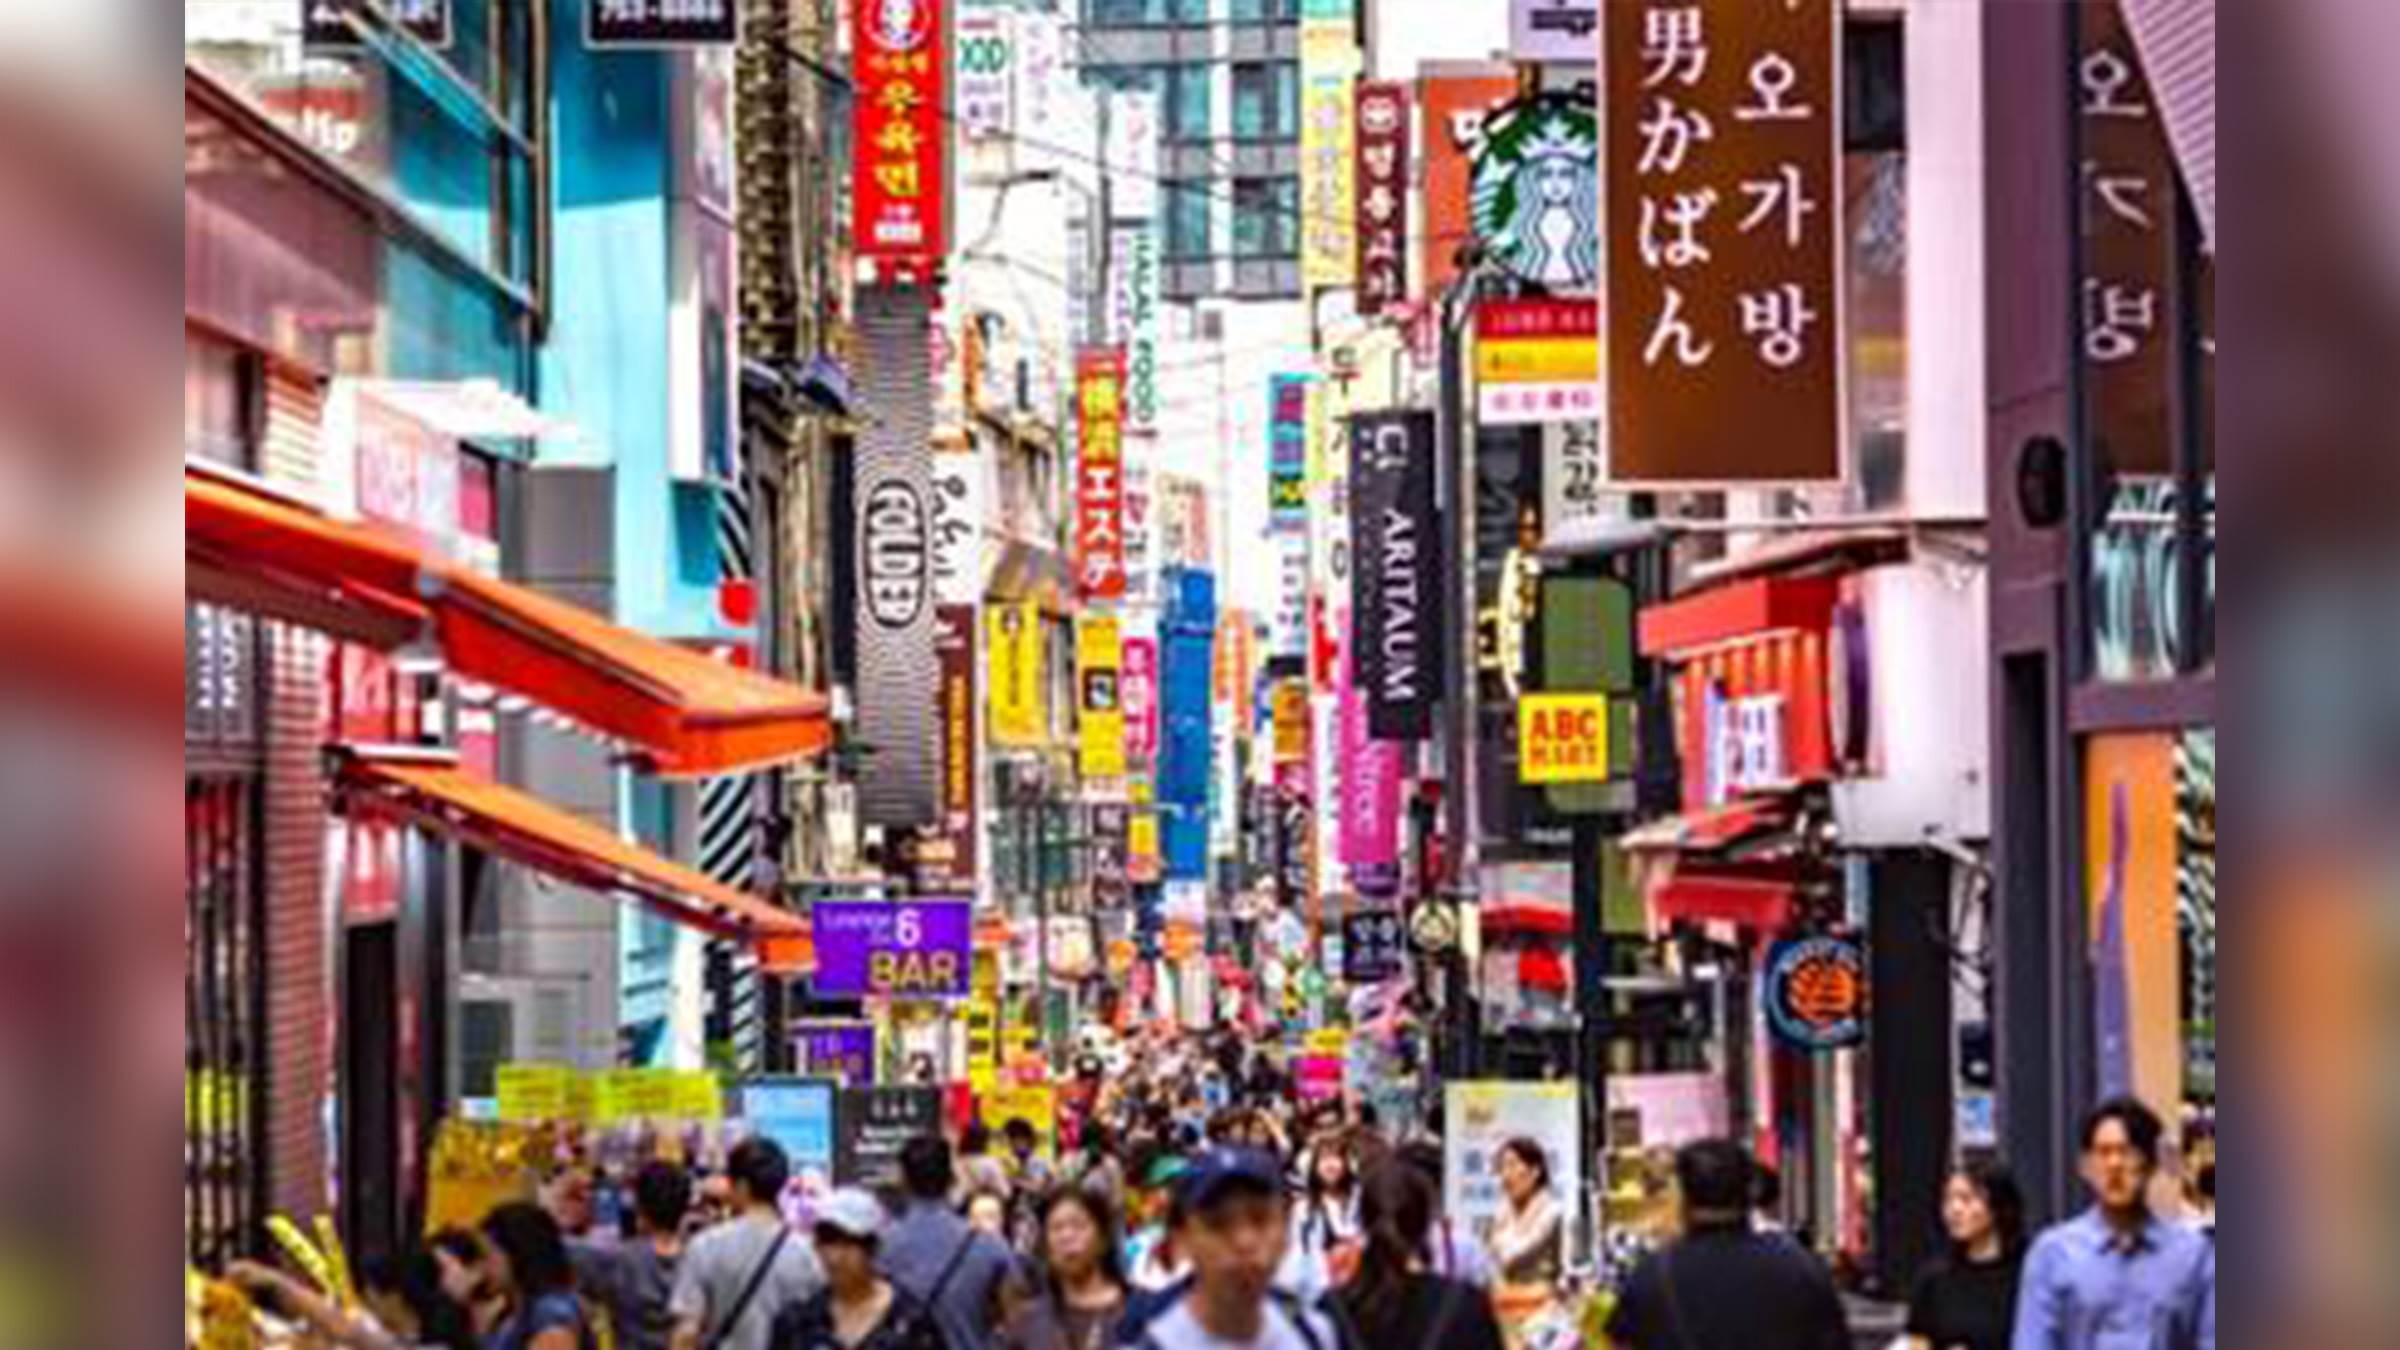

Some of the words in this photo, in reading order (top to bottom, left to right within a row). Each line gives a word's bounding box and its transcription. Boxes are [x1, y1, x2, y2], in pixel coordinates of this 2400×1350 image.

[1637, 7, 1718, 366] 男かばん
[1734, 0, 1817, 366] 오가방
[867, 487, 919, 616] FOLDER
[1382, 507, 1418, 700] ARITAUM
[1528, 708, 1597, 741] ABC
[869, 949, 958, 989] BAR
[896, 907, 921, 948] 6
